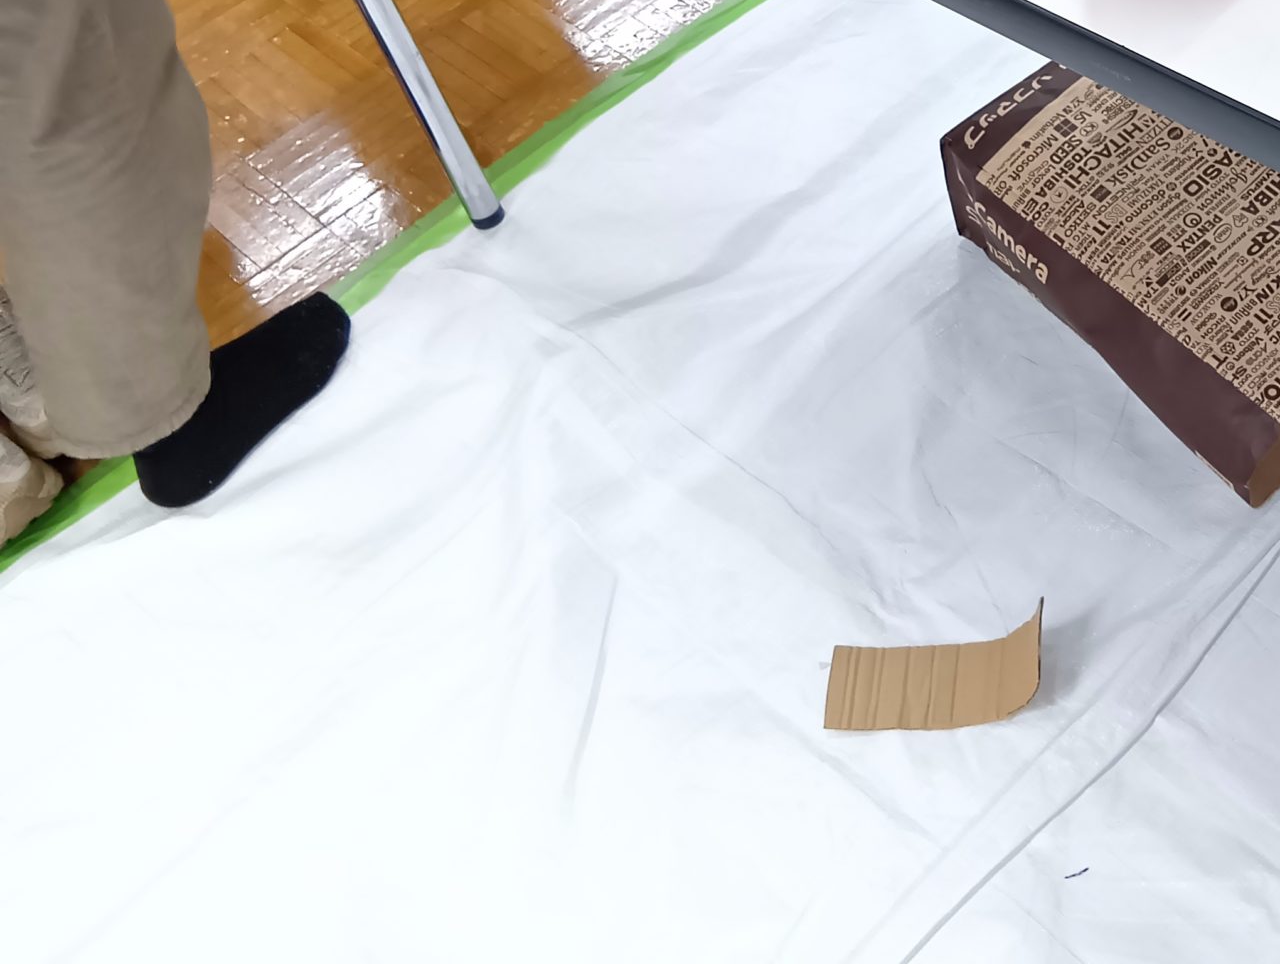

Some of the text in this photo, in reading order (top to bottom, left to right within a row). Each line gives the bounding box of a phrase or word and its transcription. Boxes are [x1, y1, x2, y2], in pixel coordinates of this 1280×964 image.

[1029, 113, 1065, 140] Verbatim
[1008, 134, 1057, 180] Microsoft
[1050, 135, 1082, 163] SEED
[1064, 118, 1142, 191] HITACHI
[1105, 132, 1169, 193] SanDisk
[1031, 164, 1055, 187] Lexar
[1035, 147, 1091, 197] TOSHIBA
[1092, 173, 1144, 222] PRINCETON
[1125, 186, 1165, 222] docomo
[1127, 175, 1164, 211] TAKIZUMI
[1156, 189, 1180, 210] dyson
[1063, 202, 1099, 237] SEIKO
[1071, 222, 1092, 241] MTG
[1177, 214, 1222, 252] PENTAX
[1117, 237, 1139, 259] PHILIPS
[1125, 241, 1145, 261] DENON
[1185, 257, 1216, 284] Nikon
[1200, 315, 1225, 338] RICOH
[1239, 327, 1259, 346] TOTO
[1233, 337, 1263, 361] Velbon
